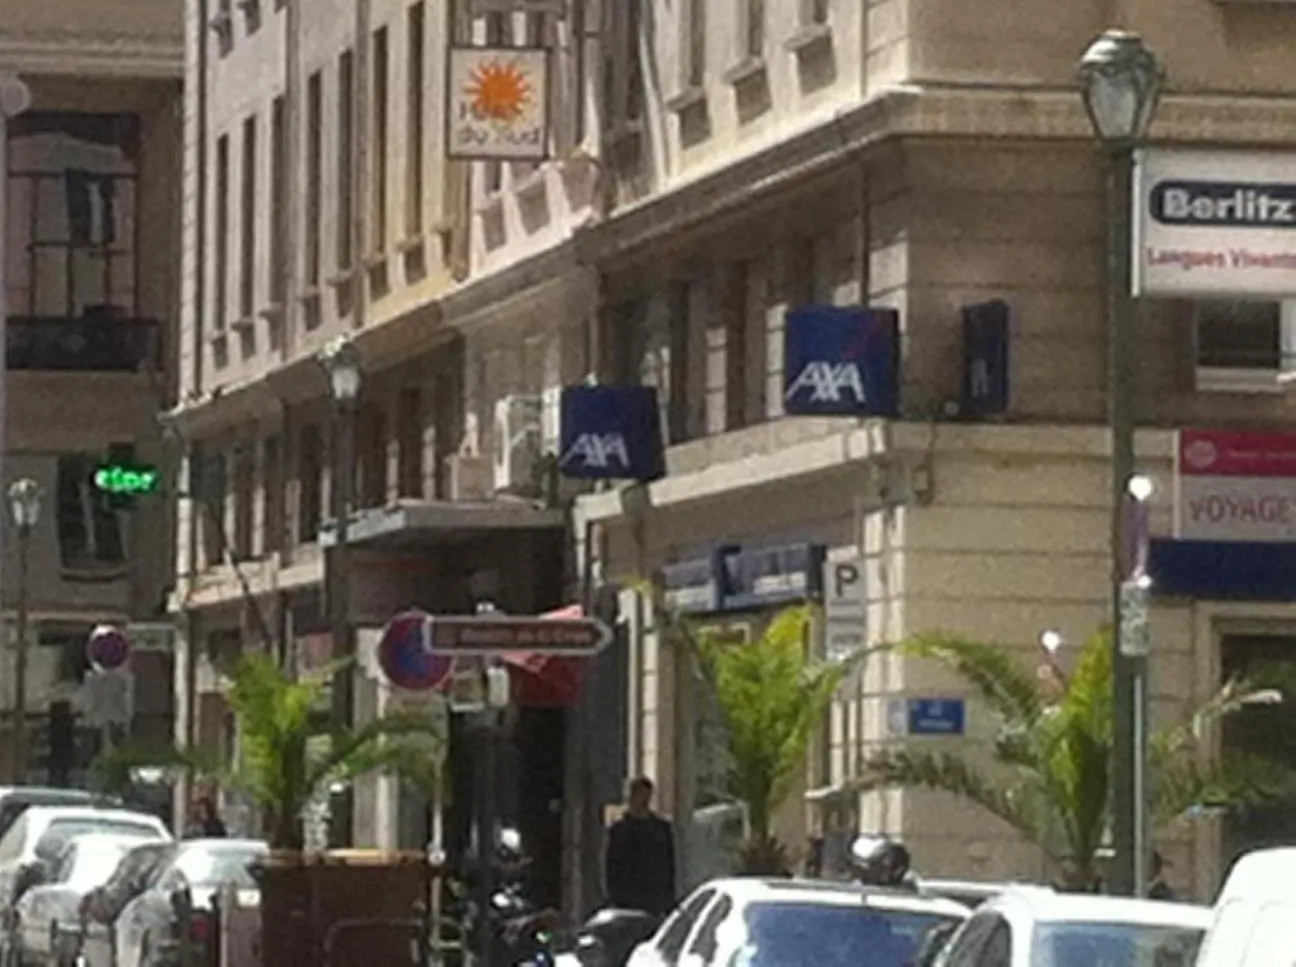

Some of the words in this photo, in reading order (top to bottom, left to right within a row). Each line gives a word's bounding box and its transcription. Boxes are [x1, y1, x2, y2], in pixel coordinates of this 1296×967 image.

[1163, 187, 1294, 221] Berlitz
[786, 360, 865, 403] AXA
[560, 432, 631, 469] AXA
[1189, 494, 1296, 525] VOYAGE
[835, 564, 859, 597] P
